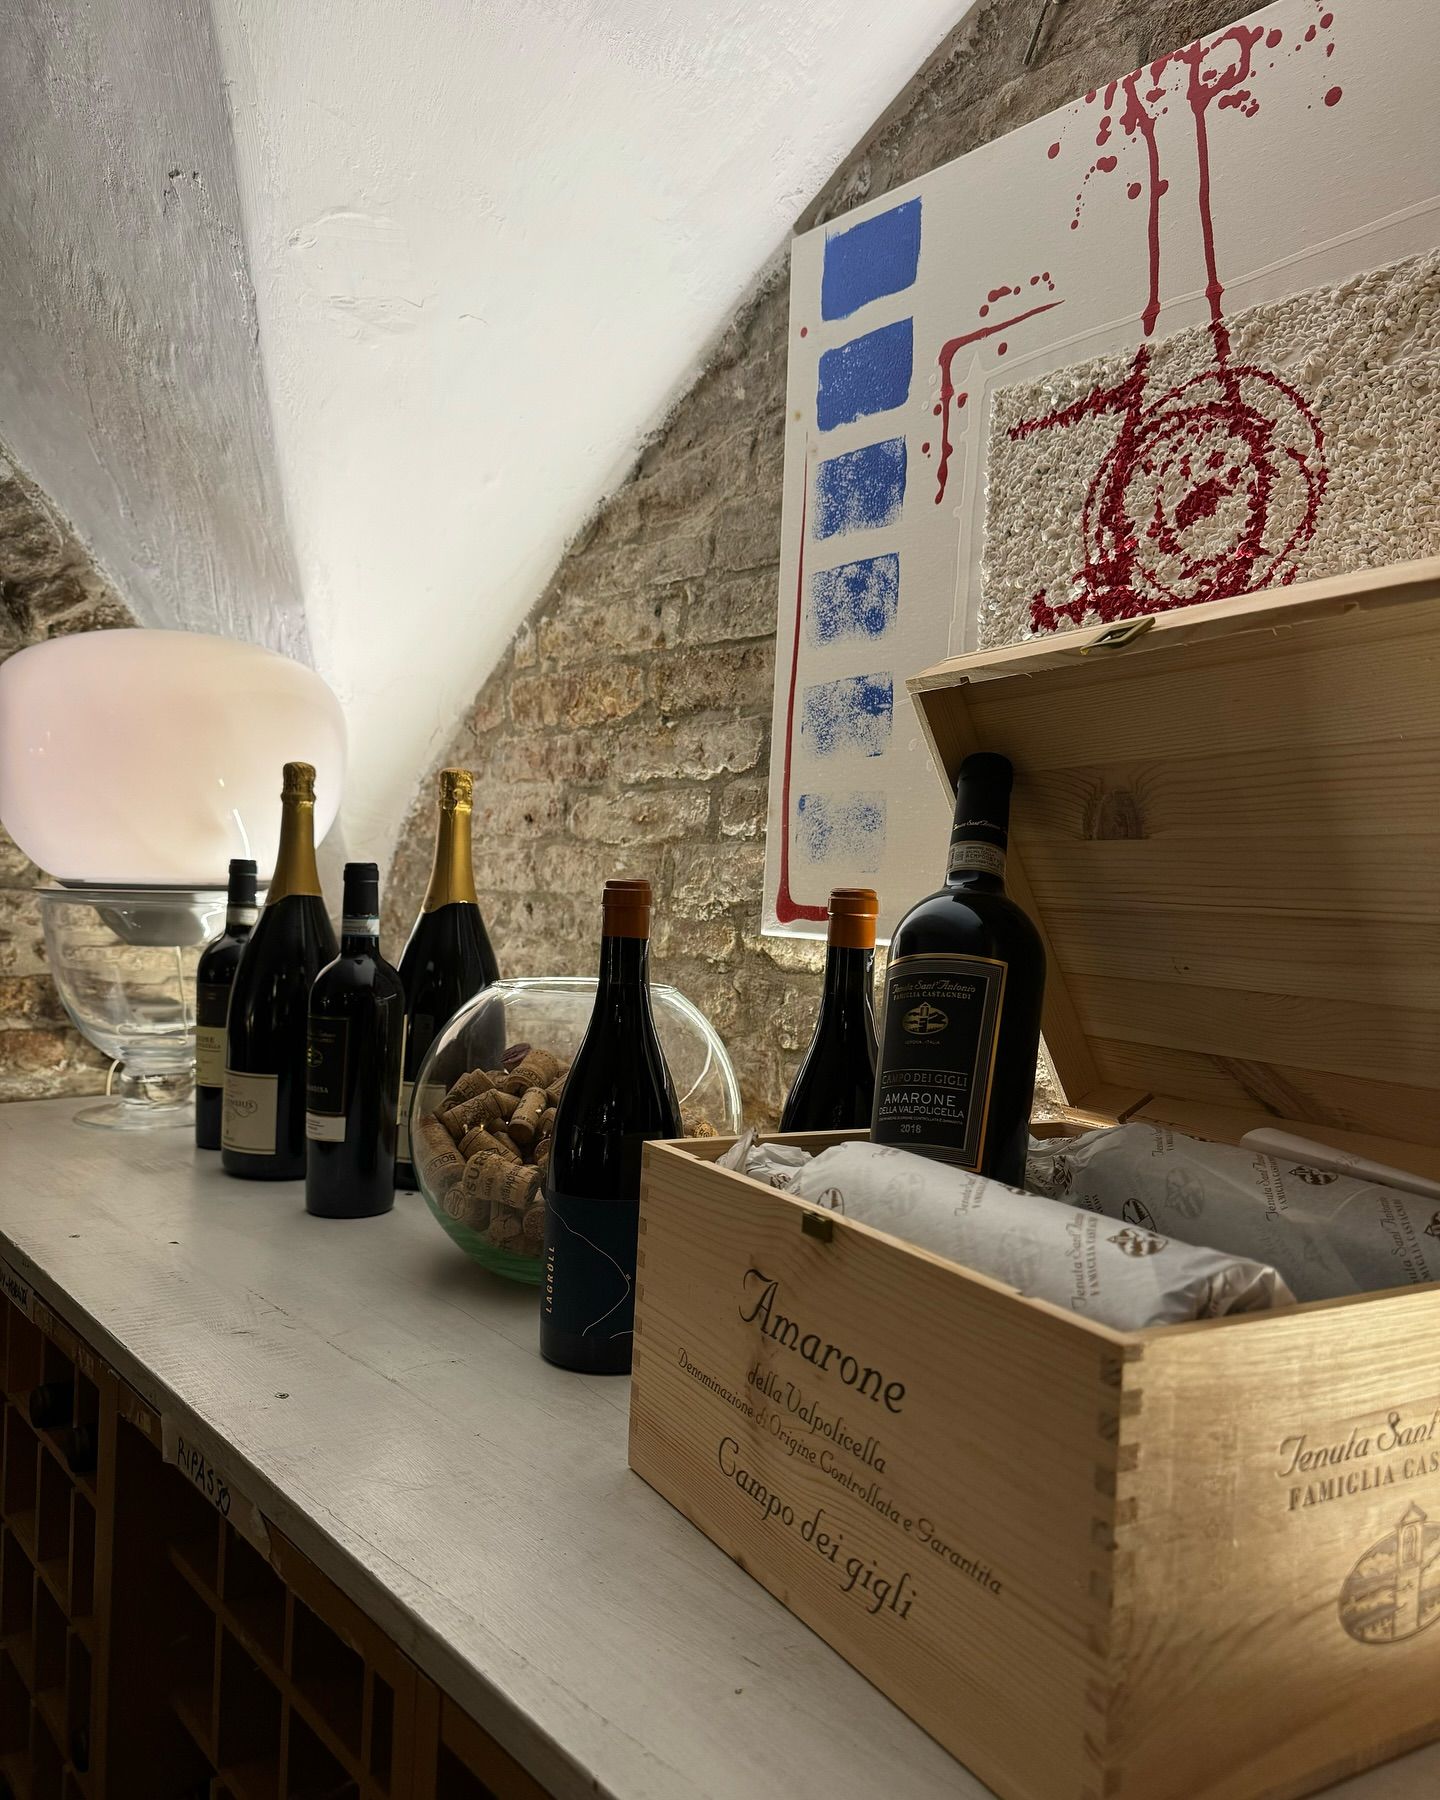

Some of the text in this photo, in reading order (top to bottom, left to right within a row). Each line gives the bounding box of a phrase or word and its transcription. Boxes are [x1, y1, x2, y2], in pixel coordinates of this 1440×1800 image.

[921, 990, 971, 1000] CASTAGNEDI
[881, 1073, 967, 1087] CAMPO DEI GIGLI
[884, 1092, 957, 1107] AMARONE
[878, 1106, 897, 1116] DELLA
[897, 1105, 965, 1119] VALPOLICELLA
[900, 1124, 922, 1134] 2018
[1070, 1262, 1088, 1312] Tenuta
[1086, 1246, 1100, 1298] FAMIGLIA
[738, 1268, 908, 1414] Amarone
[746, 1361, 887, 1475] della Valpolicella
[177, 1436, 231, 1517] RIPASSO
[677, 1347, 1003, 1596] Denominazione di Origine Controllata e Garantita
[1275, 1427, 1370, 1478] Tenuta
[1287, 1463, 1396, 1513] FAMIGLIA
[717, 1436, 919, 1621] Campo dei gigli
